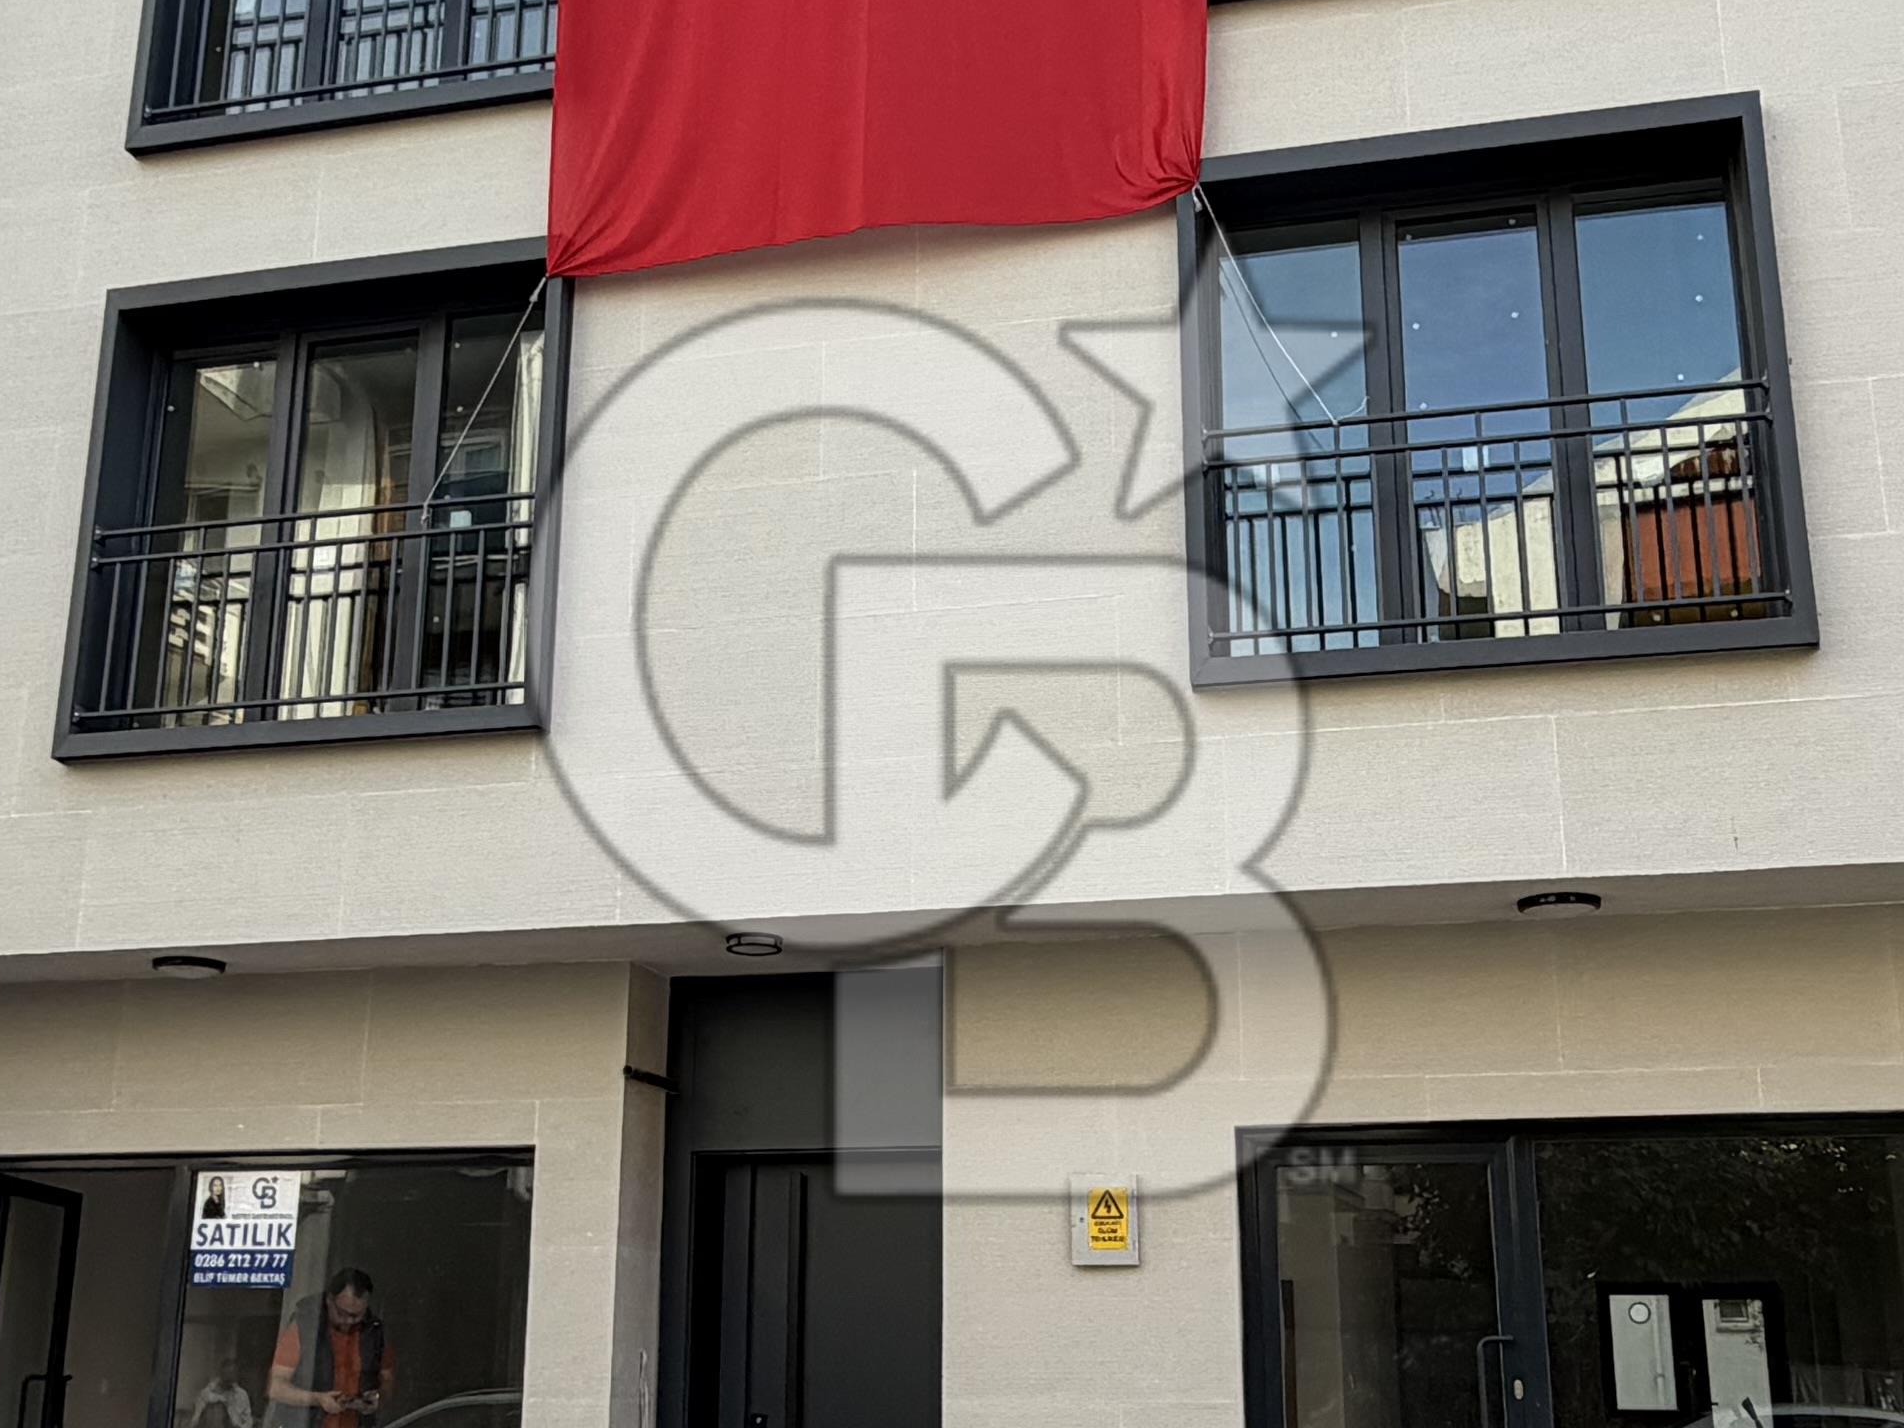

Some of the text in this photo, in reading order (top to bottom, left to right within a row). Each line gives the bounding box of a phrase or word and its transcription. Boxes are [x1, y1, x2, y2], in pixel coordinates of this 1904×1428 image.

[196, 1223, 292, 1247] SATILIK
[194, 1254, 288, 1267] 0286 212 77 77
